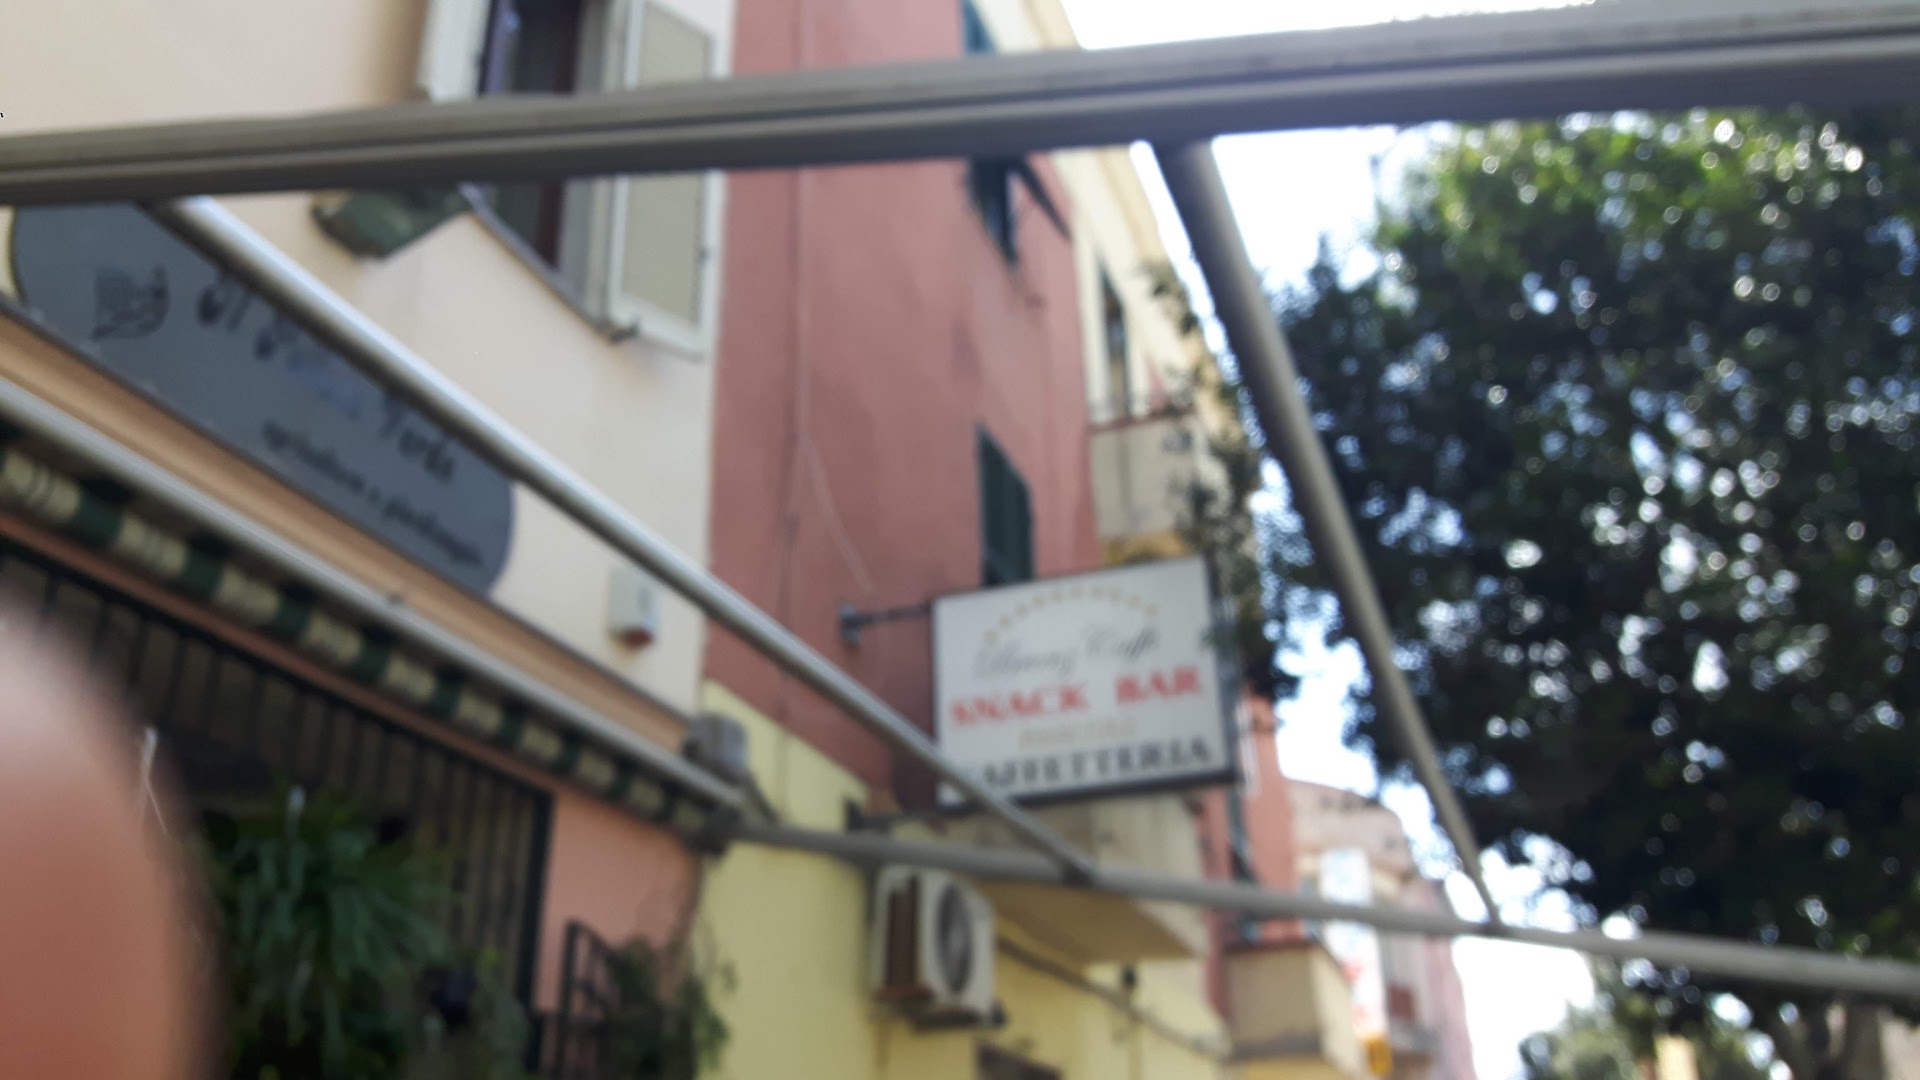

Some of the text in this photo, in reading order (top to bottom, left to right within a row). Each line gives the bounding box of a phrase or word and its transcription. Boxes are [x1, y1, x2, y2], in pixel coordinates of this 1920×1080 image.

[951, 666, 1200, 726] SNACK BAR
[972, 735, 1211, 787] AFFETTERIA
